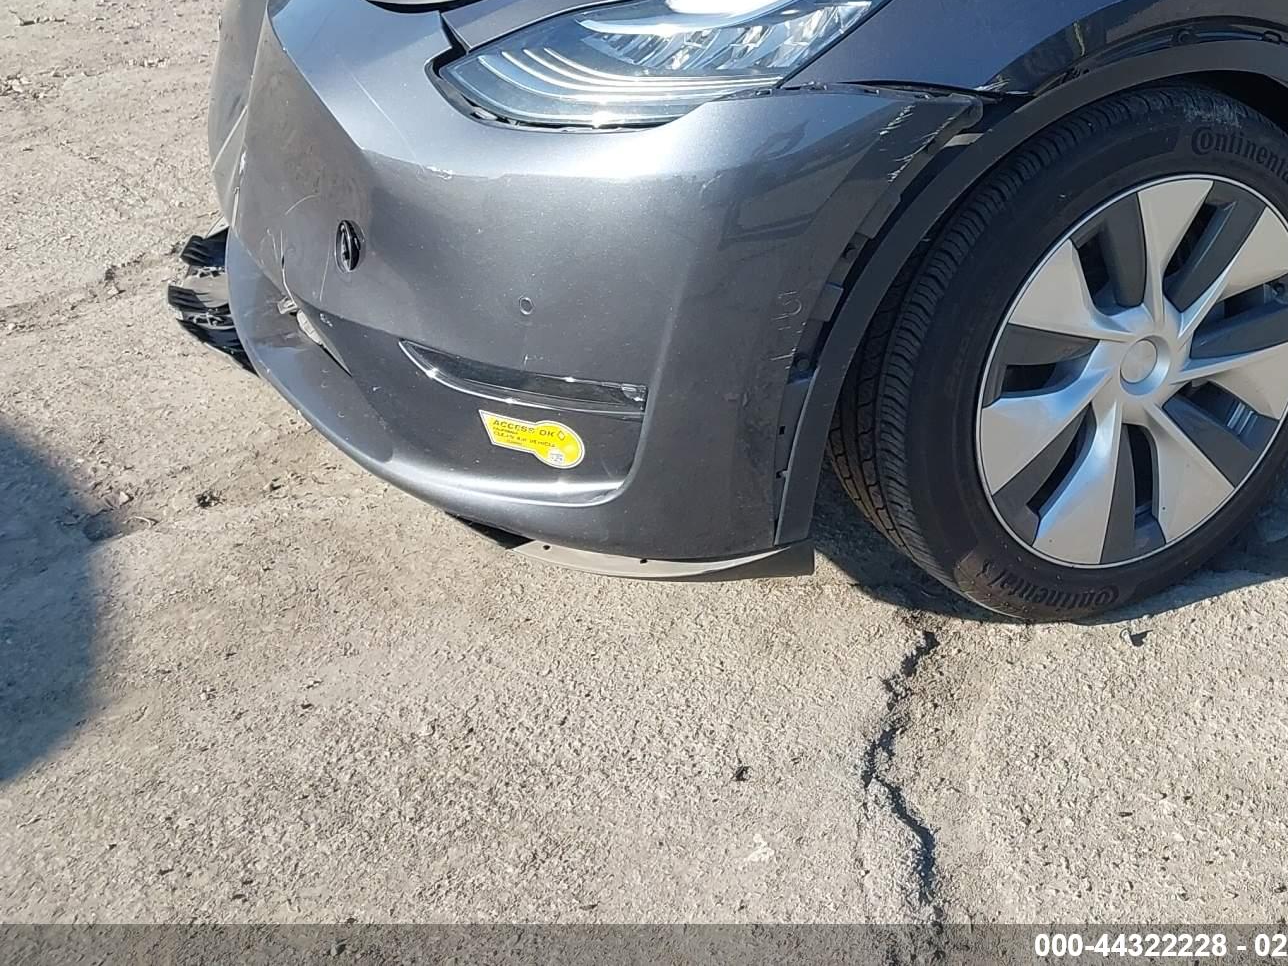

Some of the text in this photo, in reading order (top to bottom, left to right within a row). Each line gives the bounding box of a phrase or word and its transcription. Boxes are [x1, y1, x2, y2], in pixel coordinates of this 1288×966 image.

[493, 420, 555, 437] ACCESS OK
[987, 568, 1120, 611] Continental
